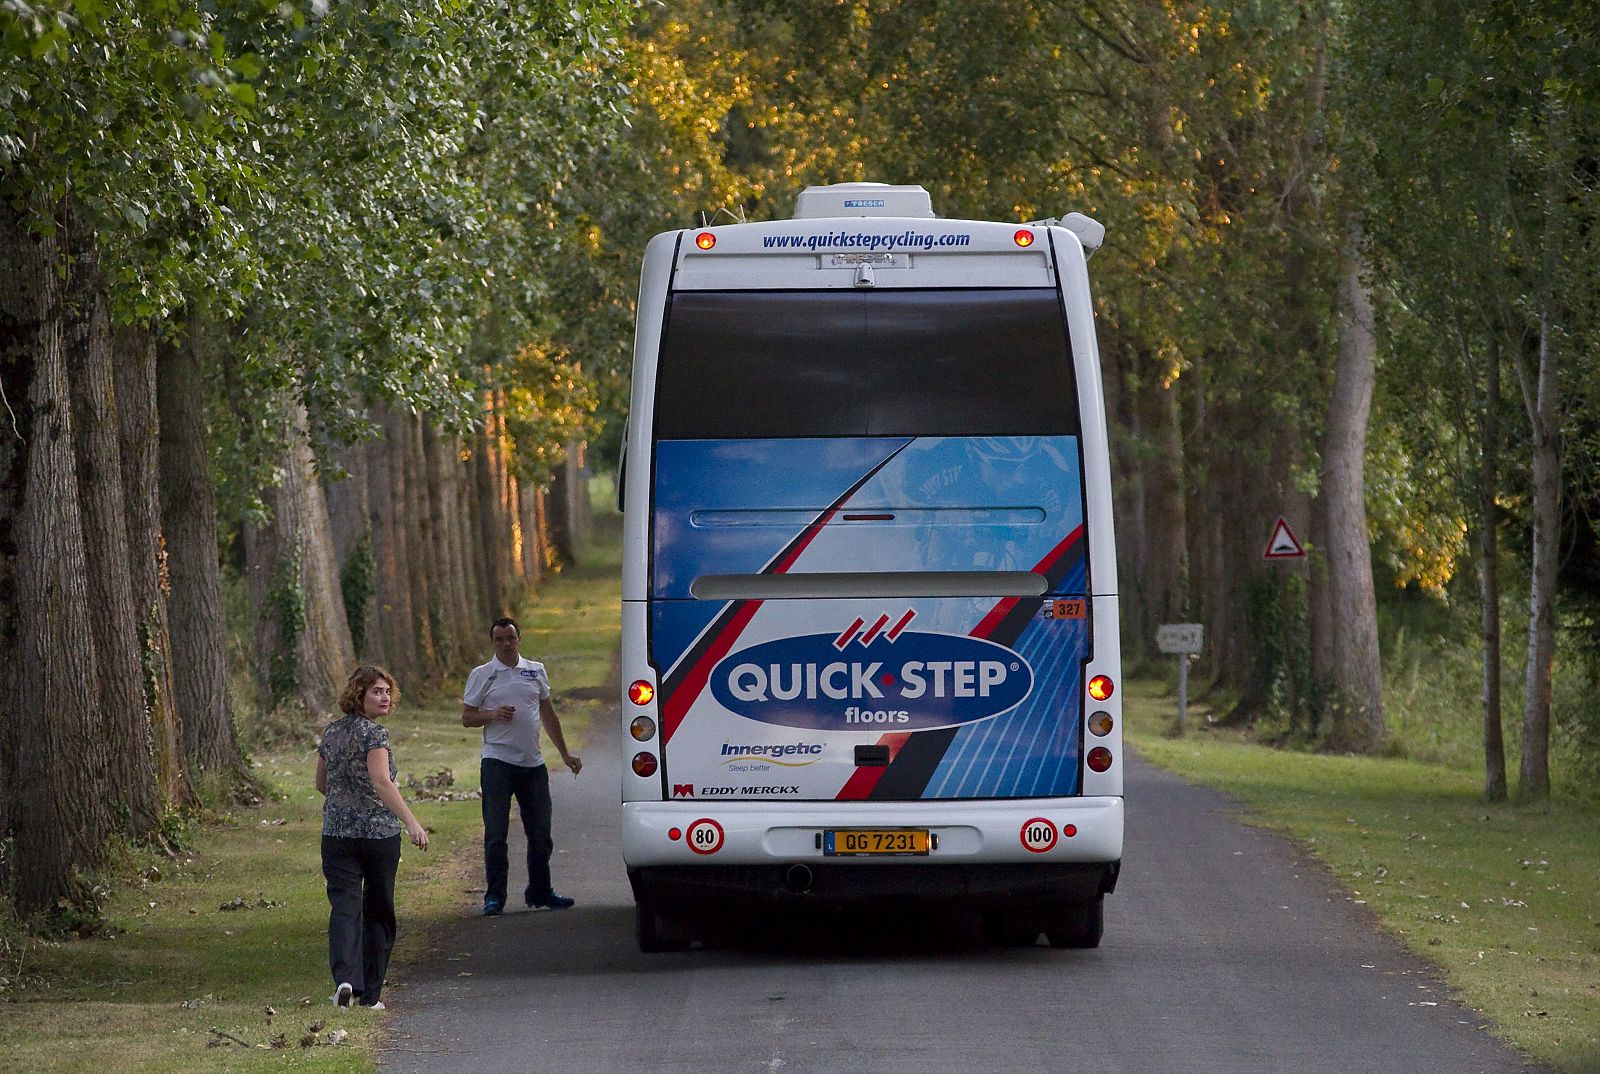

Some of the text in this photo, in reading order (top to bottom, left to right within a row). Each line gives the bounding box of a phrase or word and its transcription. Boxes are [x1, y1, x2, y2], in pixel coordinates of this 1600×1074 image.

[763, 231, 971, 251] www.quickstepcycling.com
[1058, 603, 1080, 616] 327
[728, 660, 1008, 702] QUICK STEP
[845, 706, 909, 724] floors
[728, 764, 771, 773] Sleep better
[701, 785, 800, 796] EDDY MERCKX
[696, 828, 714, 844] 80
[846, 834, 916, 850] QG 7231
[1027, 827, 1052, 842] 100
